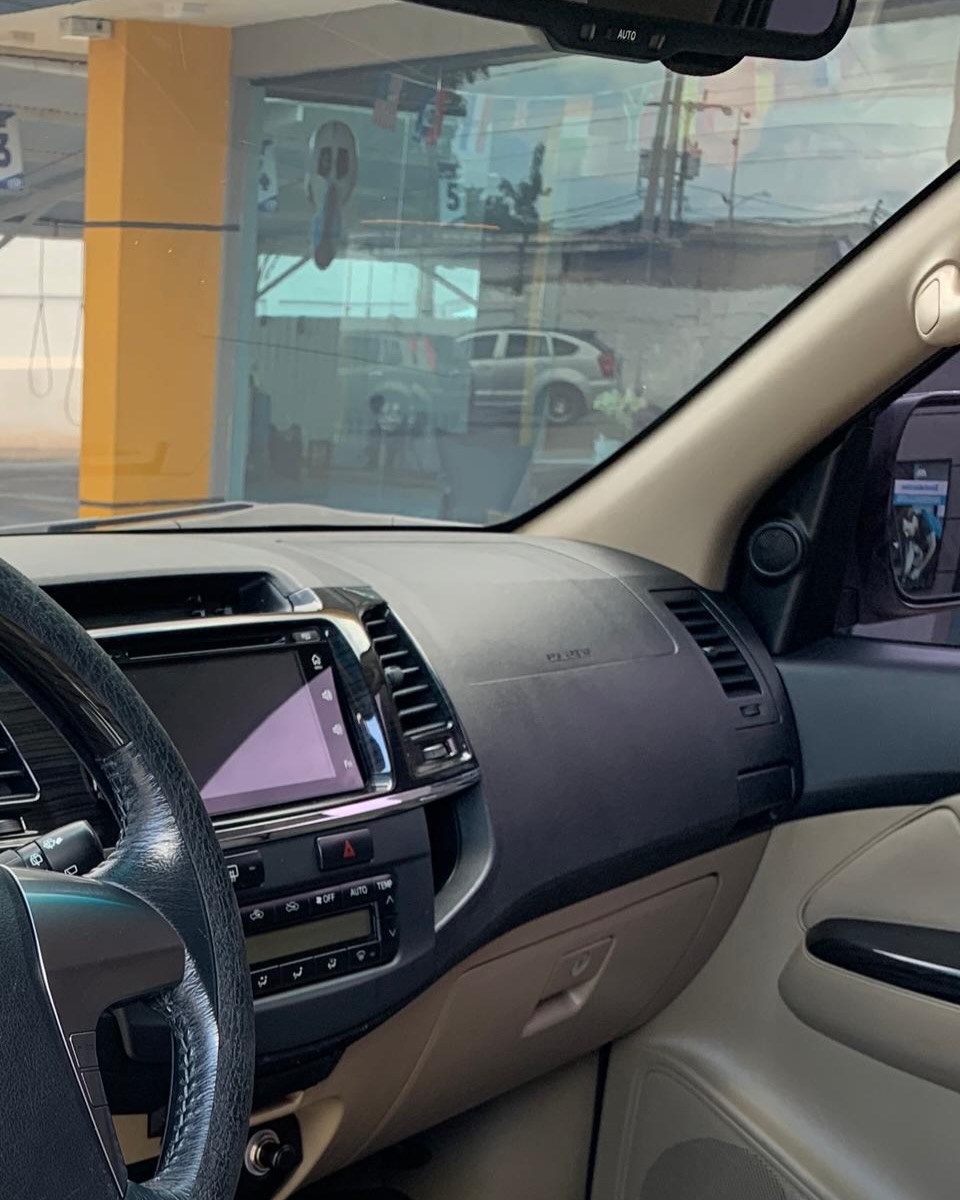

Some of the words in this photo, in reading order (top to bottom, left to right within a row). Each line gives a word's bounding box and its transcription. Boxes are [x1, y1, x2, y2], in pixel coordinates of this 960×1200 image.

[617, 28, 638, 41] AUTO
[350, 885, 368, 898] AUTO
[376, 878, 393, 892] TEMP
[322, 892, 336, 905] OFF
